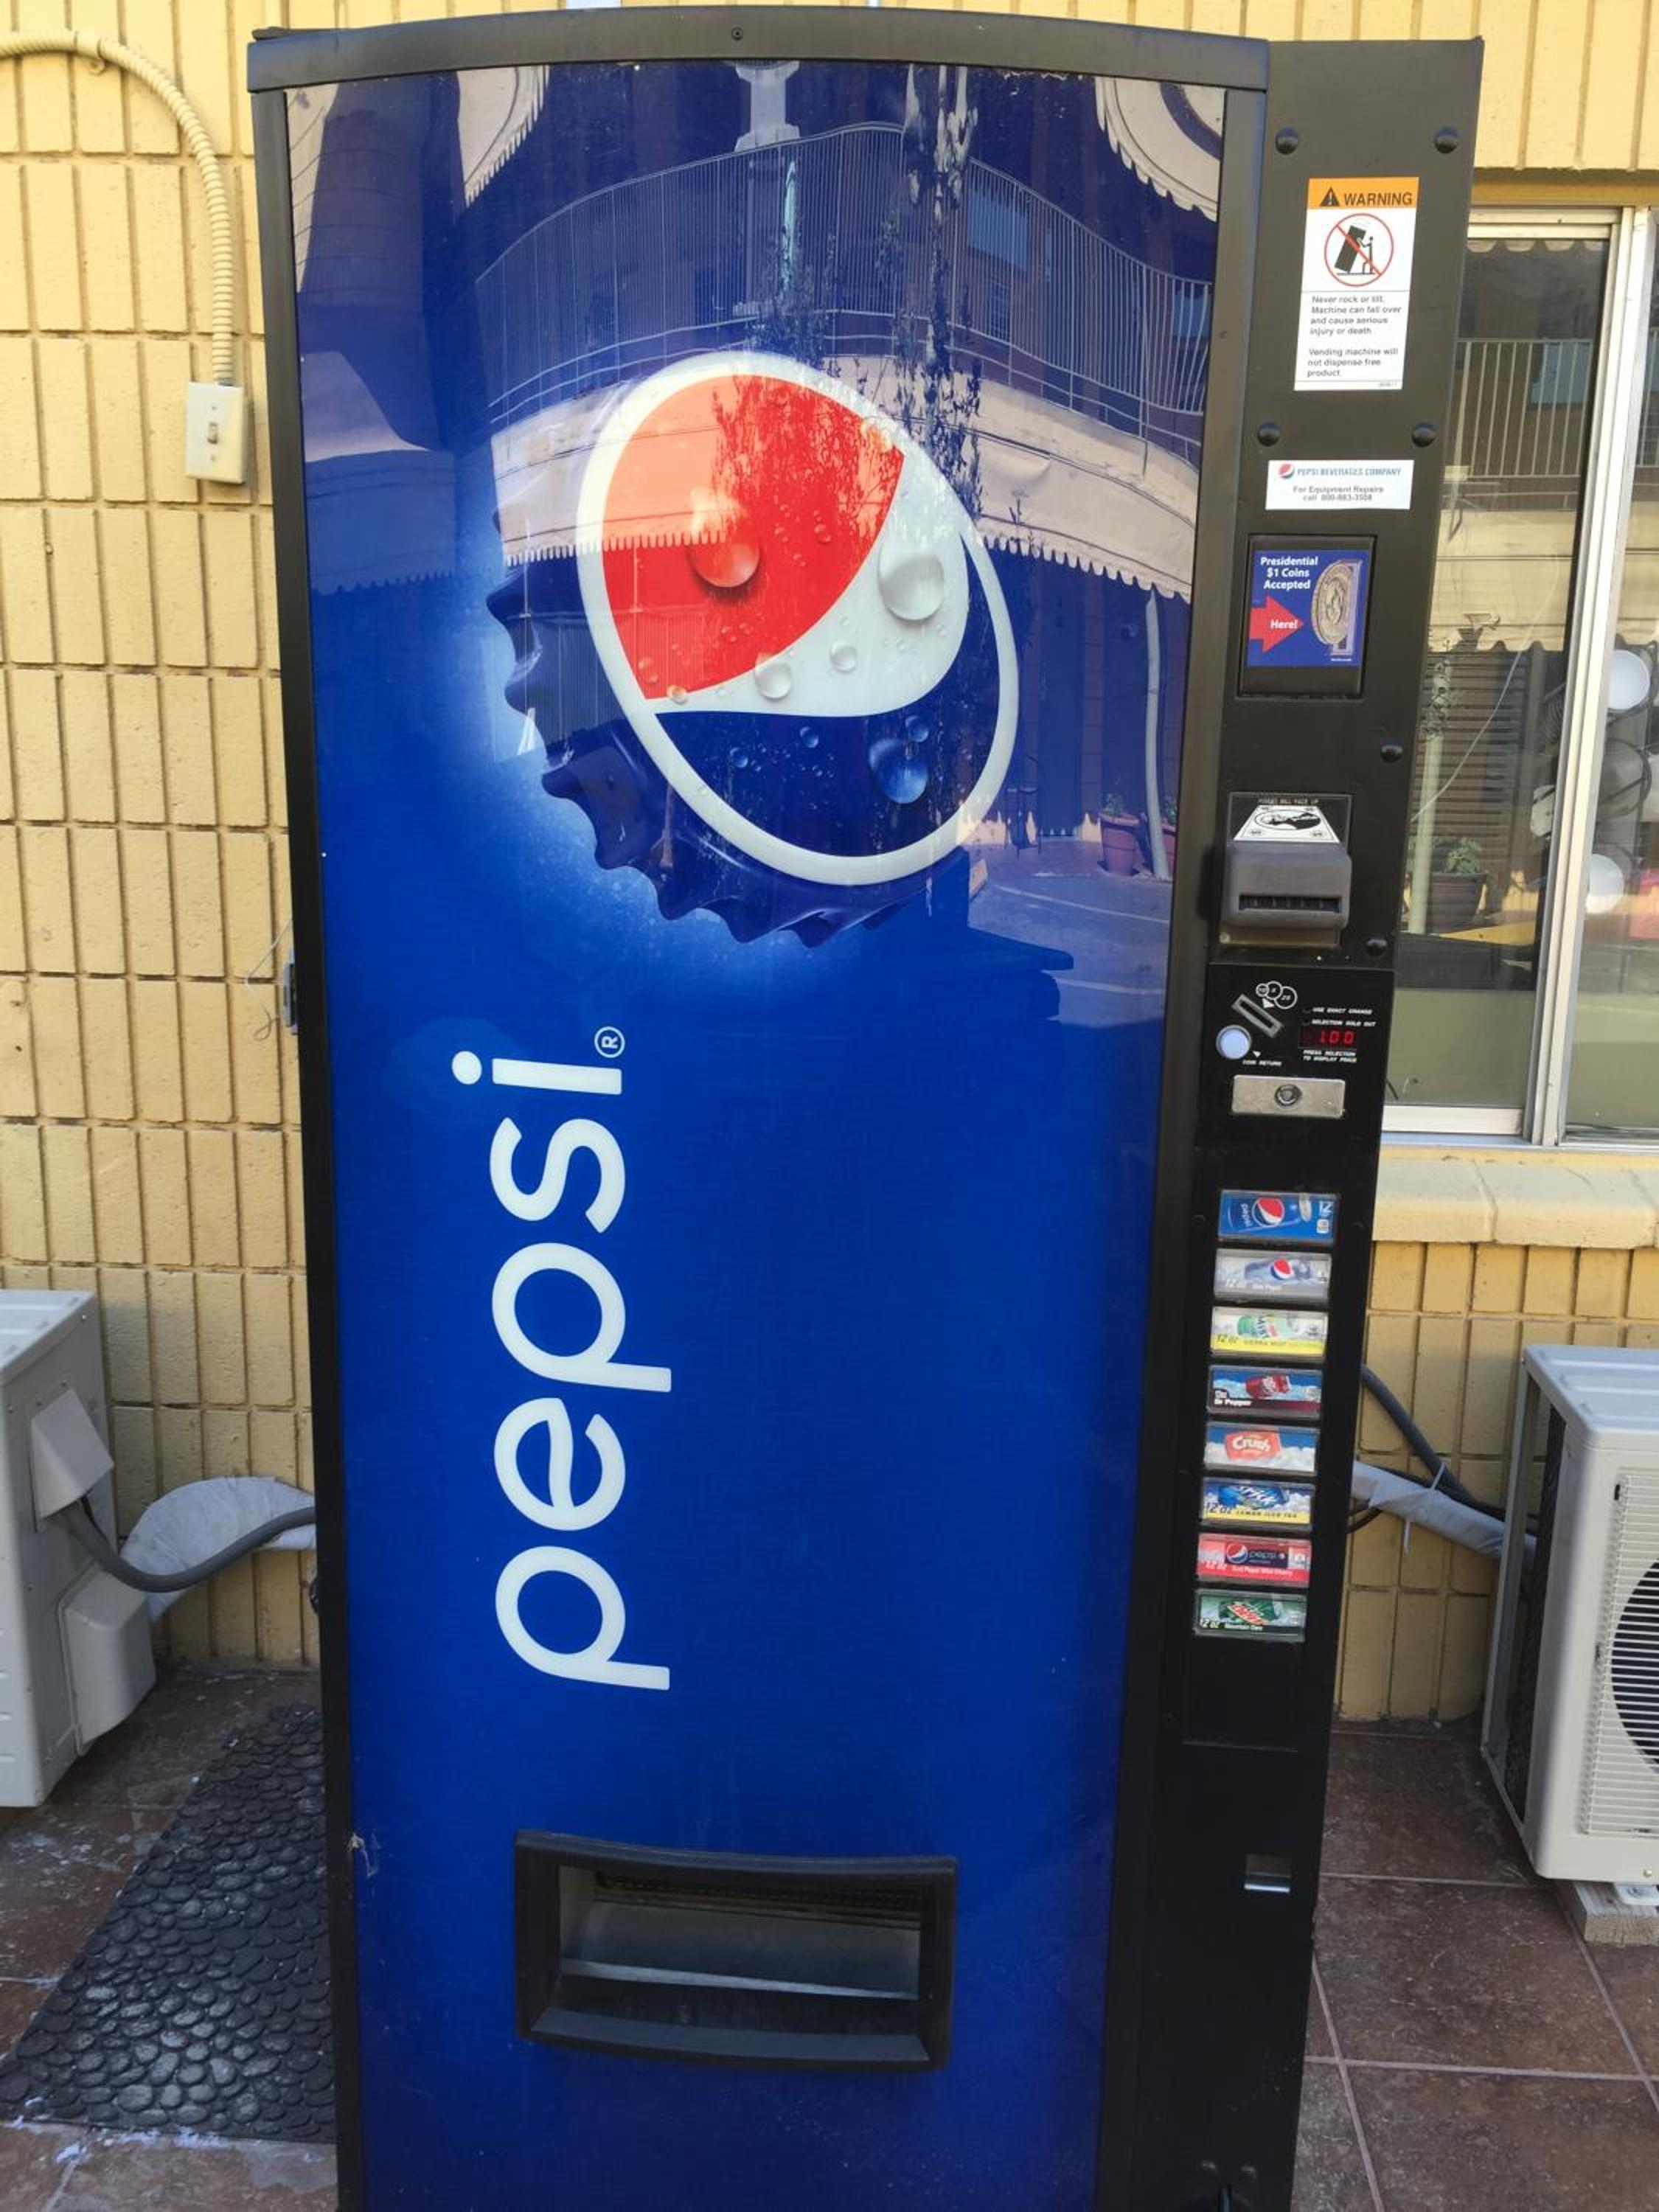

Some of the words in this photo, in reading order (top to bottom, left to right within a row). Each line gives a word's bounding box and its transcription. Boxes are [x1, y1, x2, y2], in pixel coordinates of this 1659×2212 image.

[1344, 192, 1412, 206] WARNING
[1310, 328, 1333, 336] injury
[1309, 348, 1342, 357] Vending
[1324, 358, 1363, 366] dispense
[1297, 468, 1318, 476] PEPSI
[1365, 468, 1401, 476] COMPANY
[1309, 486, 1351, 495] Equipment
[1260, 557, 1318, 566] Presidential
[1267, 567, 1279, 577] $1
[1281, 568, 1310, 577] Coins
[1264, 580, 1311, 591] Accepted
[1270, 619, 1298, 629] Here!
[452, 1051, 672, 1691] pepsi
[1232, 1437, 1270, 1452] Crush
